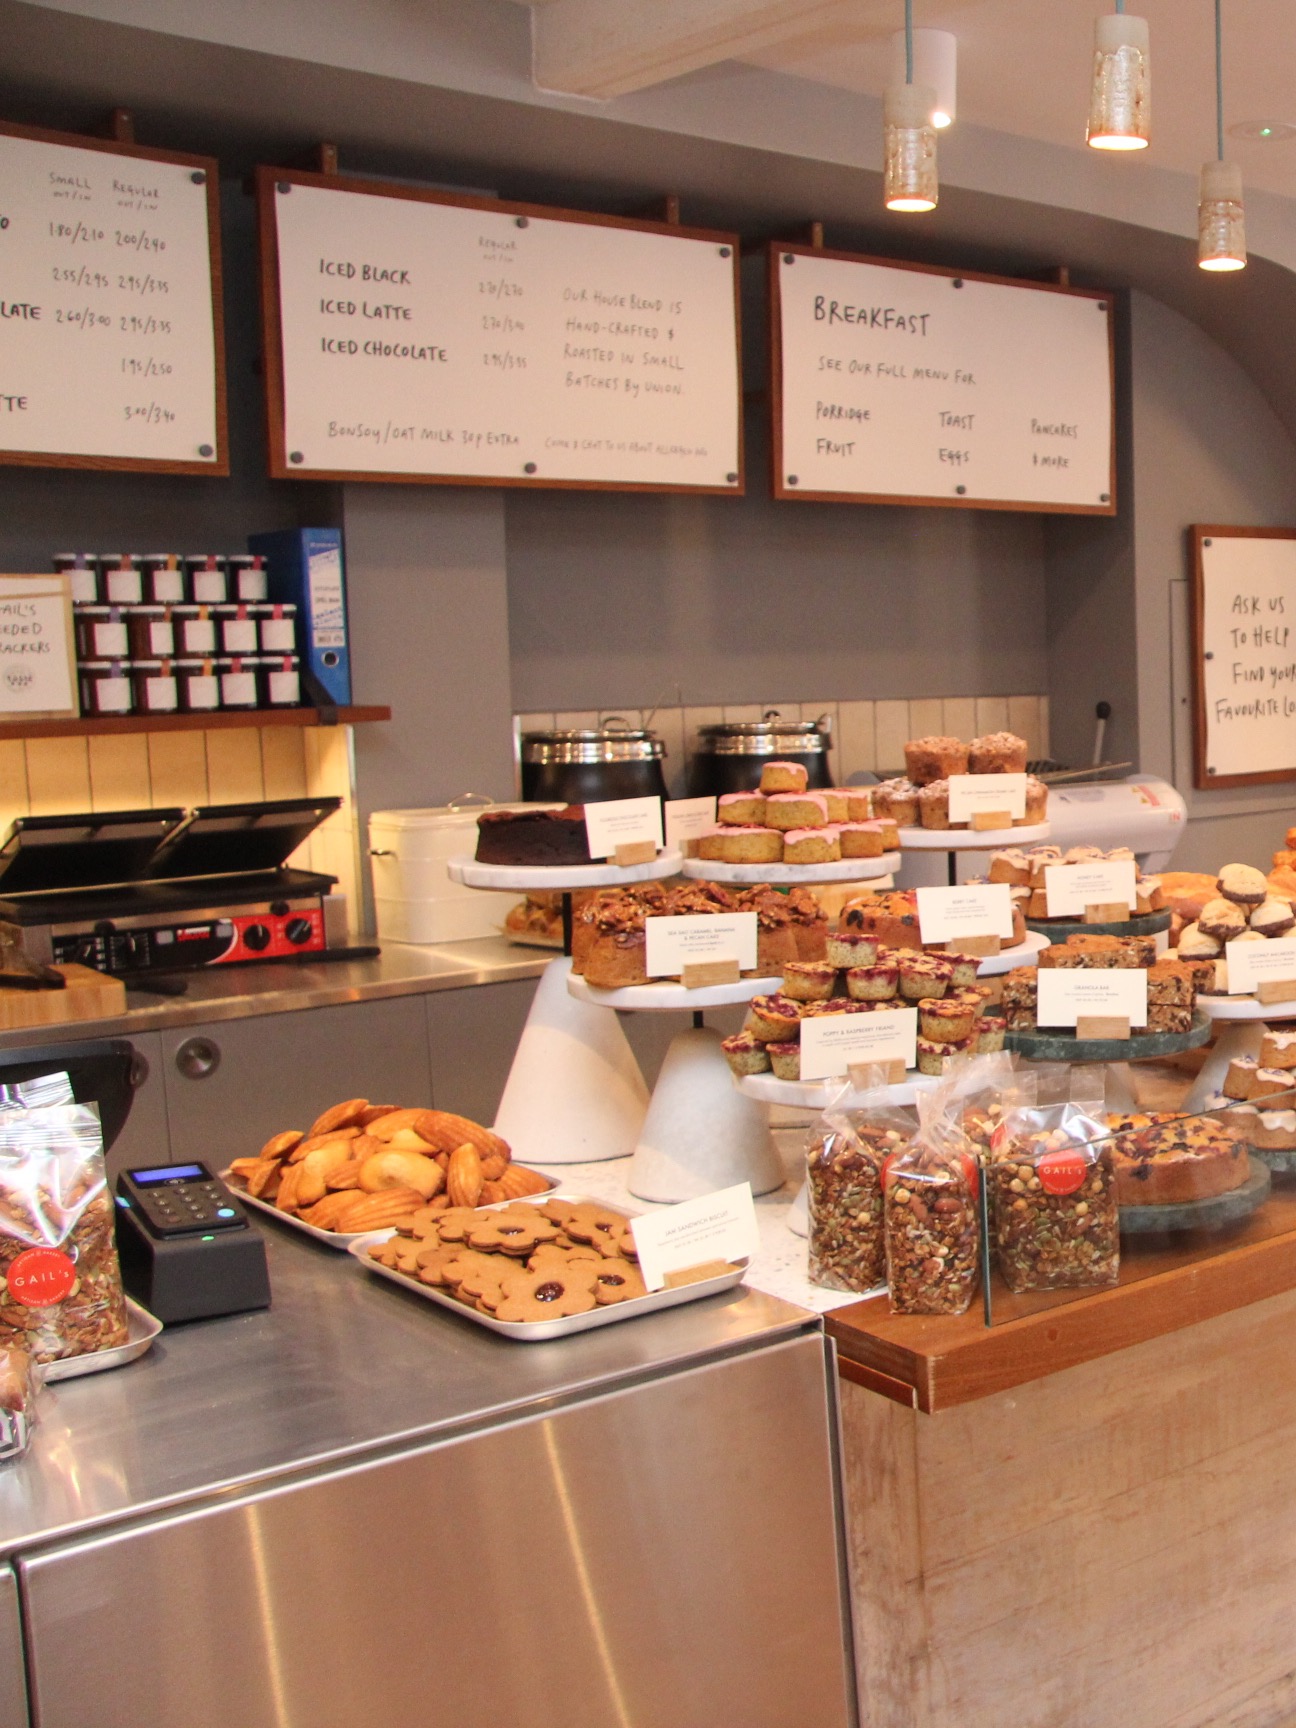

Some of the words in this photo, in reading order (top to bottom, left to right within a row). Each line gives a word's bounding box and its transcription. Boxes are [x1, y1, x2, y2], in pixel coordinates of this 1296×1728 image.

[49, 171, 91, 190] SMALL
[112, 178, 159, 198] REGULAR
[319, 258, 356, 279] ICED
[362, 263, 411, 285] BLACK
[320, 298, 357, 316] ICED
[362, 300, 412, 321] LATTE
[562, 287, 588, 302] OUR
[594, 290, 626, 307] HOUSE
[629, 293, 662, 312] BLEND
[669, 301, 683, 314] IS
[813, 294, 931, 337] BREAKFAST
[565, 317, 659, 340] HAND-CRAFTED
[321, 337, 358, 355] ICED
[363, 340, 448, 362] CHOCOLATE
[563, 342, 614, 363] ROASTED
[621, 352, 635, 364] IN
[642, 351, 684, 370] SMALL
[817, 355, 843, 372] SEE
[848, 359, 872, 376] OUR
[876, 361, 907, 380] FULL
[912, 366, 950, 382] MENU
[953, 369, 977, 385] FOR
[565, 371, 619, 391] BATCHES
[624, 378, 639, 398] BY
[645, 383, 682, 396] UNION
[815, 400, 872, 421] PORRIDGE
[938, 410, 976, 431] TOAST
[420, 428, 455, 444] MILK
[1030, 417, 1079, 440] PANCAKES
[815, 437, 857, 457] FRUIT
[937, 448, 971, 467] EGGS
[1040, 455, 1070, 469] MORE
[0, 602, 37, 617] AIL'S
[1231, 593, 1262, 616] ASK
[1267, 595, 1285, 614] US
[0, 622, 43, 637] EDED
[1229, 627, 1248, 649] TO
[1252, 624, 1290, 649] HELP
[1231, 661, 1265, 684] FIND
[1214, 697, 1279, 724] FAVOURITE
[846, 1026, 874, 1034] RASPBERRY
[677, 1217, 709, 1232] SANDWICH
